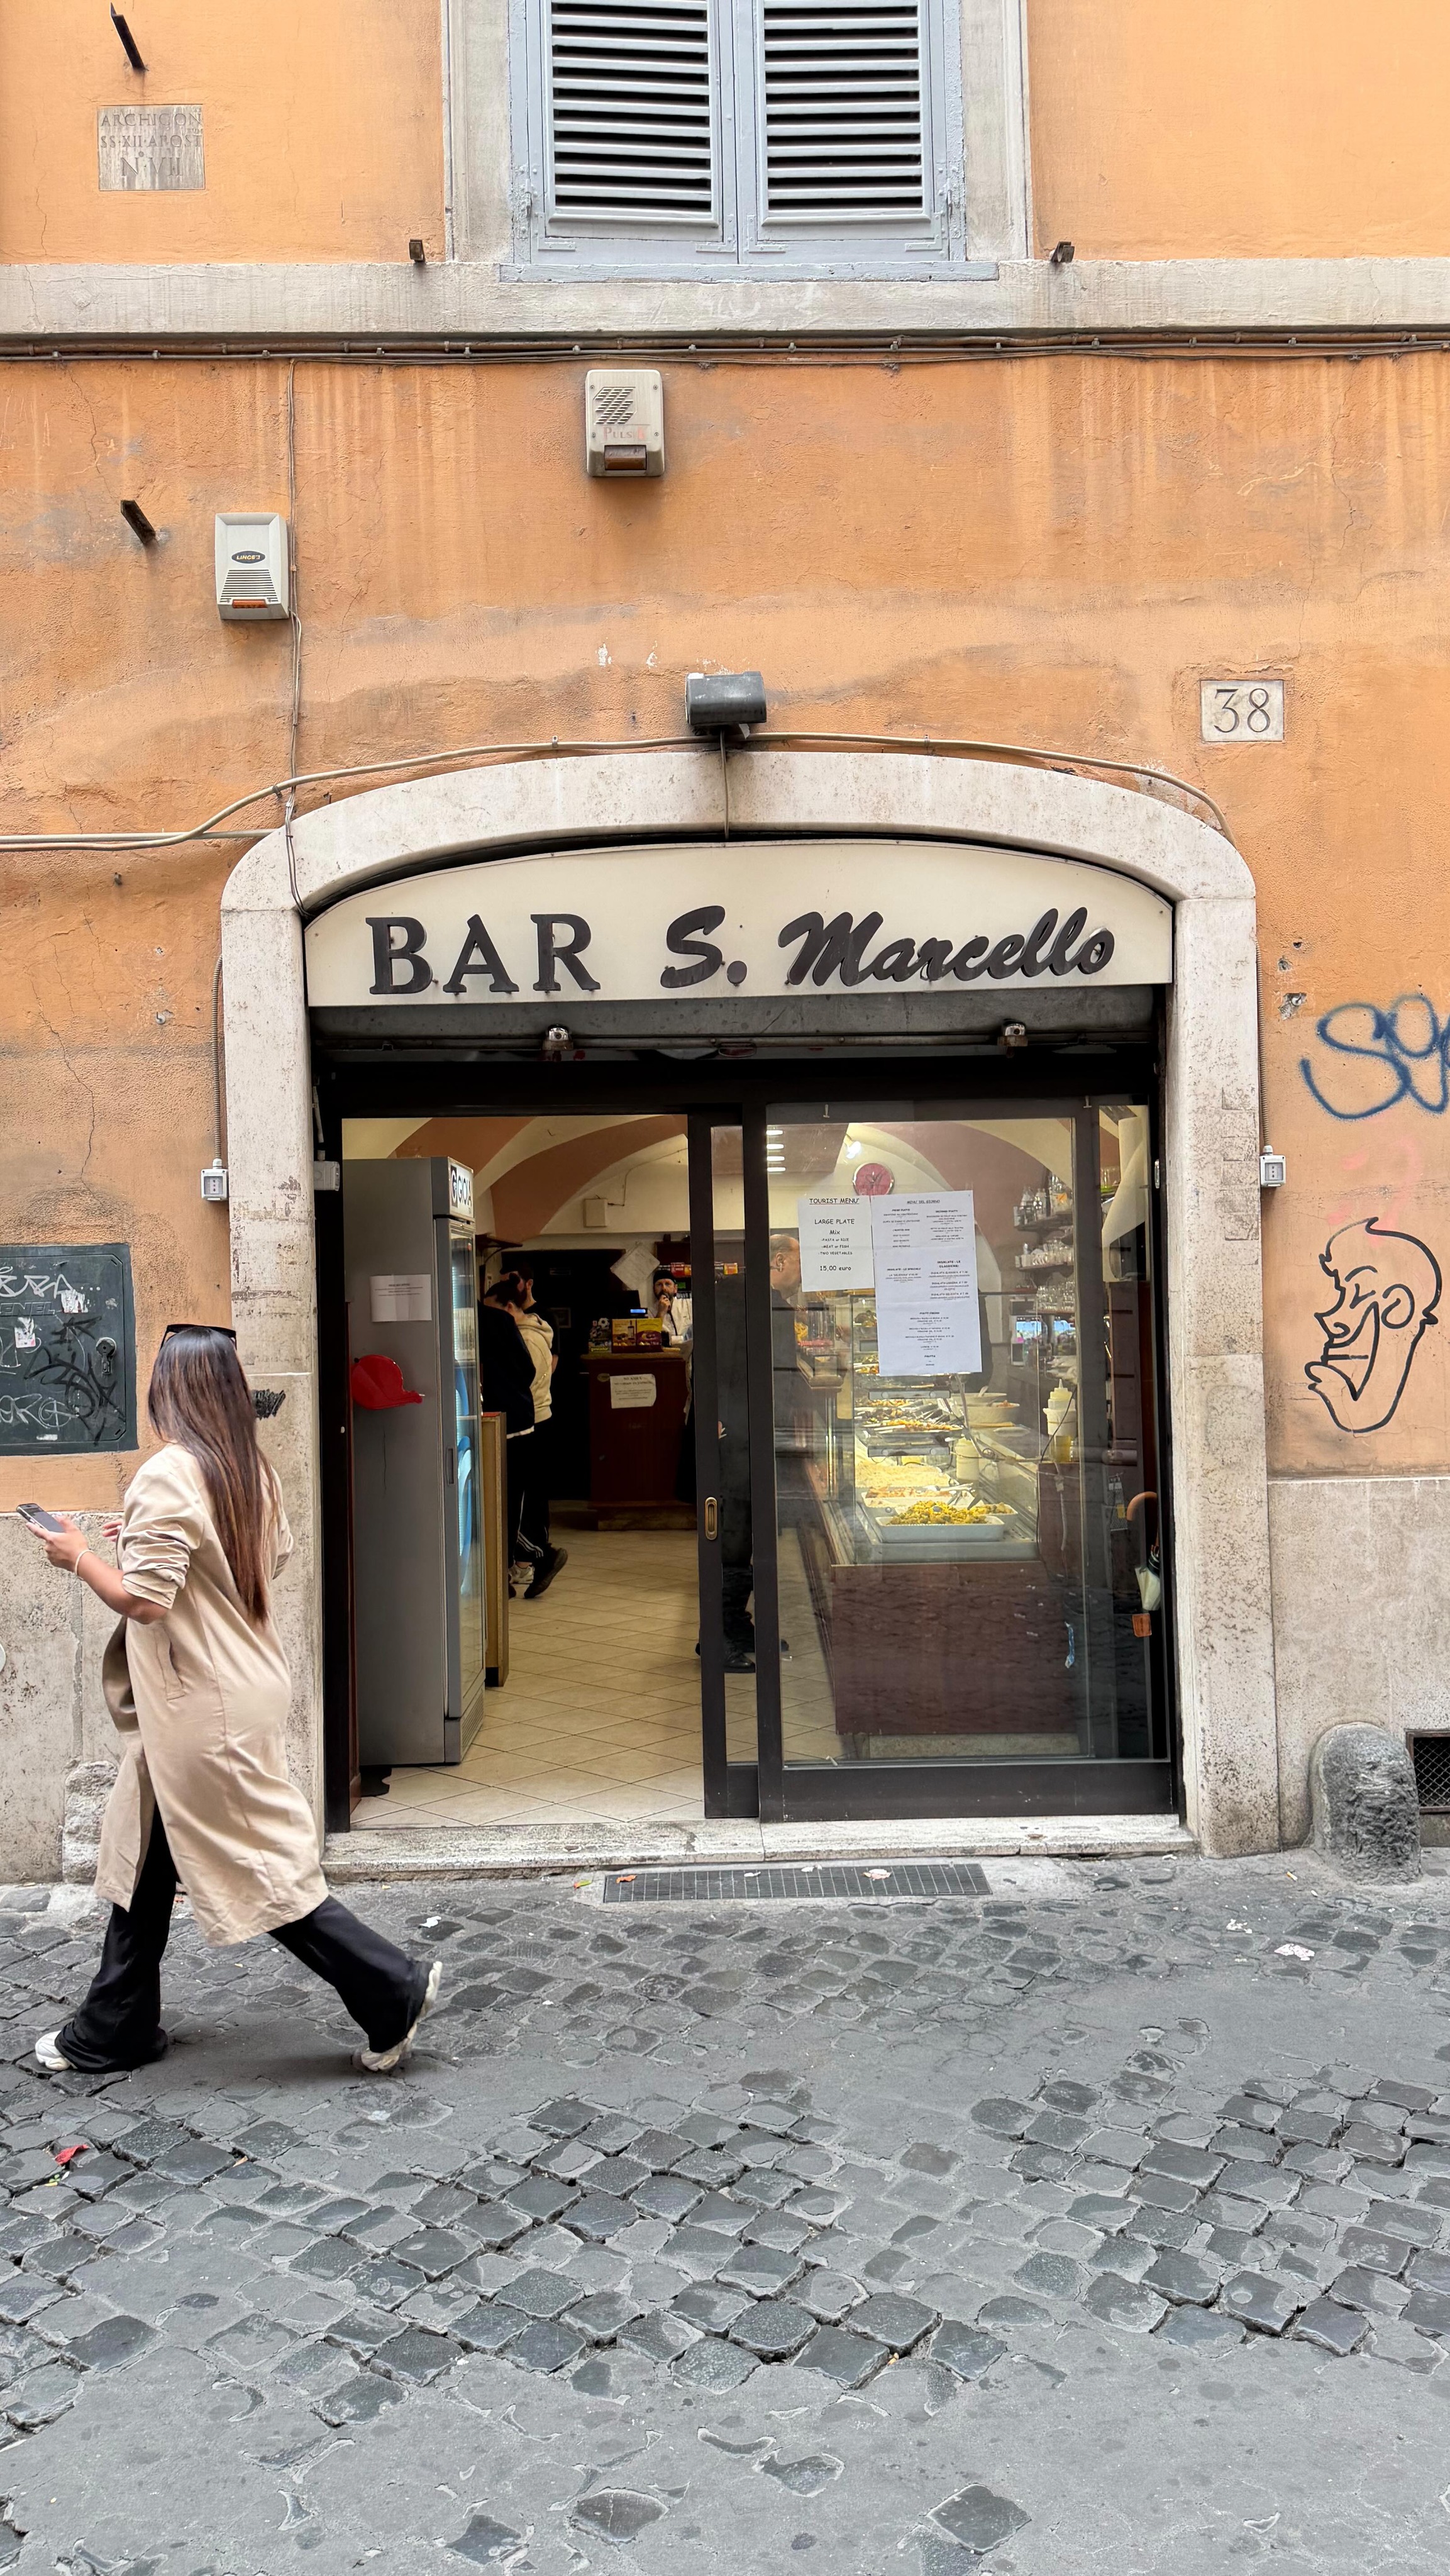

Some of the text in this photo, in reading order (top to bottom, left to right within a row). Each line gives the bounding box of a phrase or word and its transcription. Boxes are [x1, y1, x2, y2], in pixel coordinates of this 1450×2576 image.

[1214, 687, 1271, 733] 38
[365, 905, 1115, 995] BAR S. Marcello
[0, 1301, 55, 1316] ENEL
